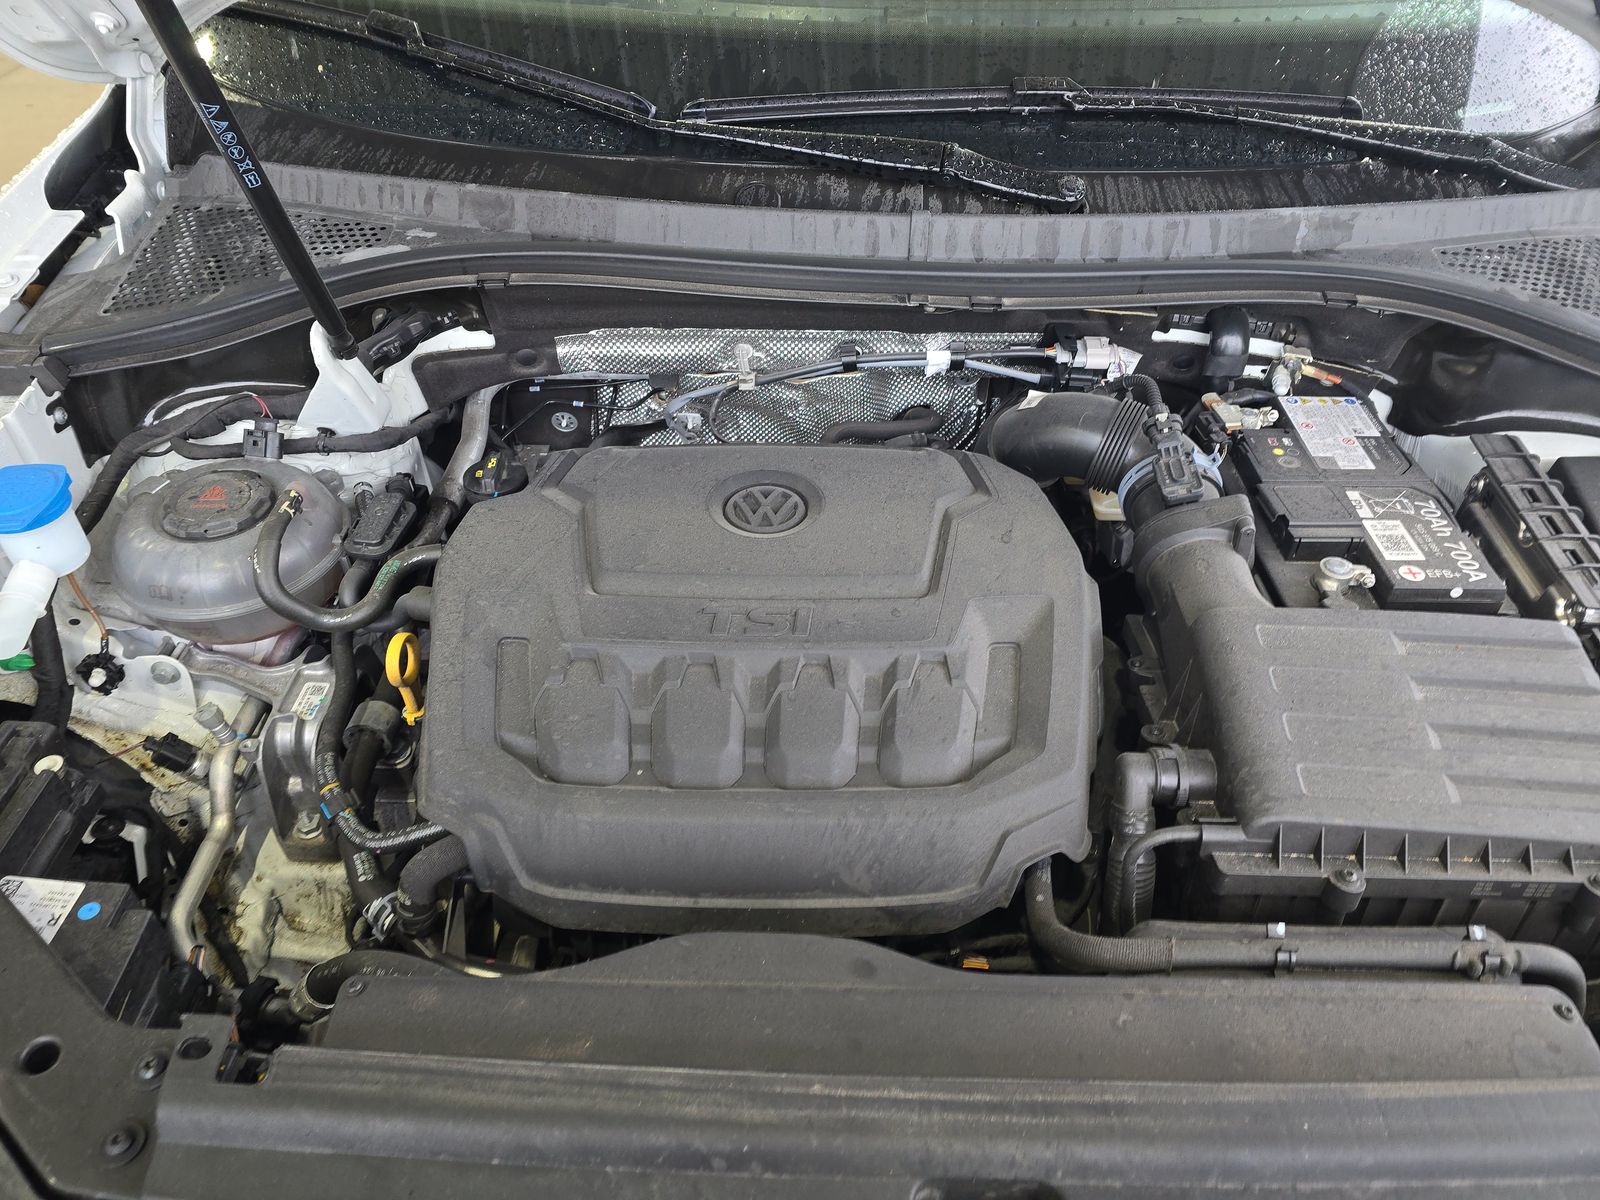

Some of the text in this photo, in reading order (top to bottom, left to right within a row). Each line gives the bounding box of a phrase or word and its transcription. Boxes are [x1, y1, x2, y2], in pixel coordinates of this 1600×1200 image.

[1414, 500, 1453, 537] 70Ah
[1443, 541, 1487, 582] 700A
[702, 605, 817, 637] TSI
